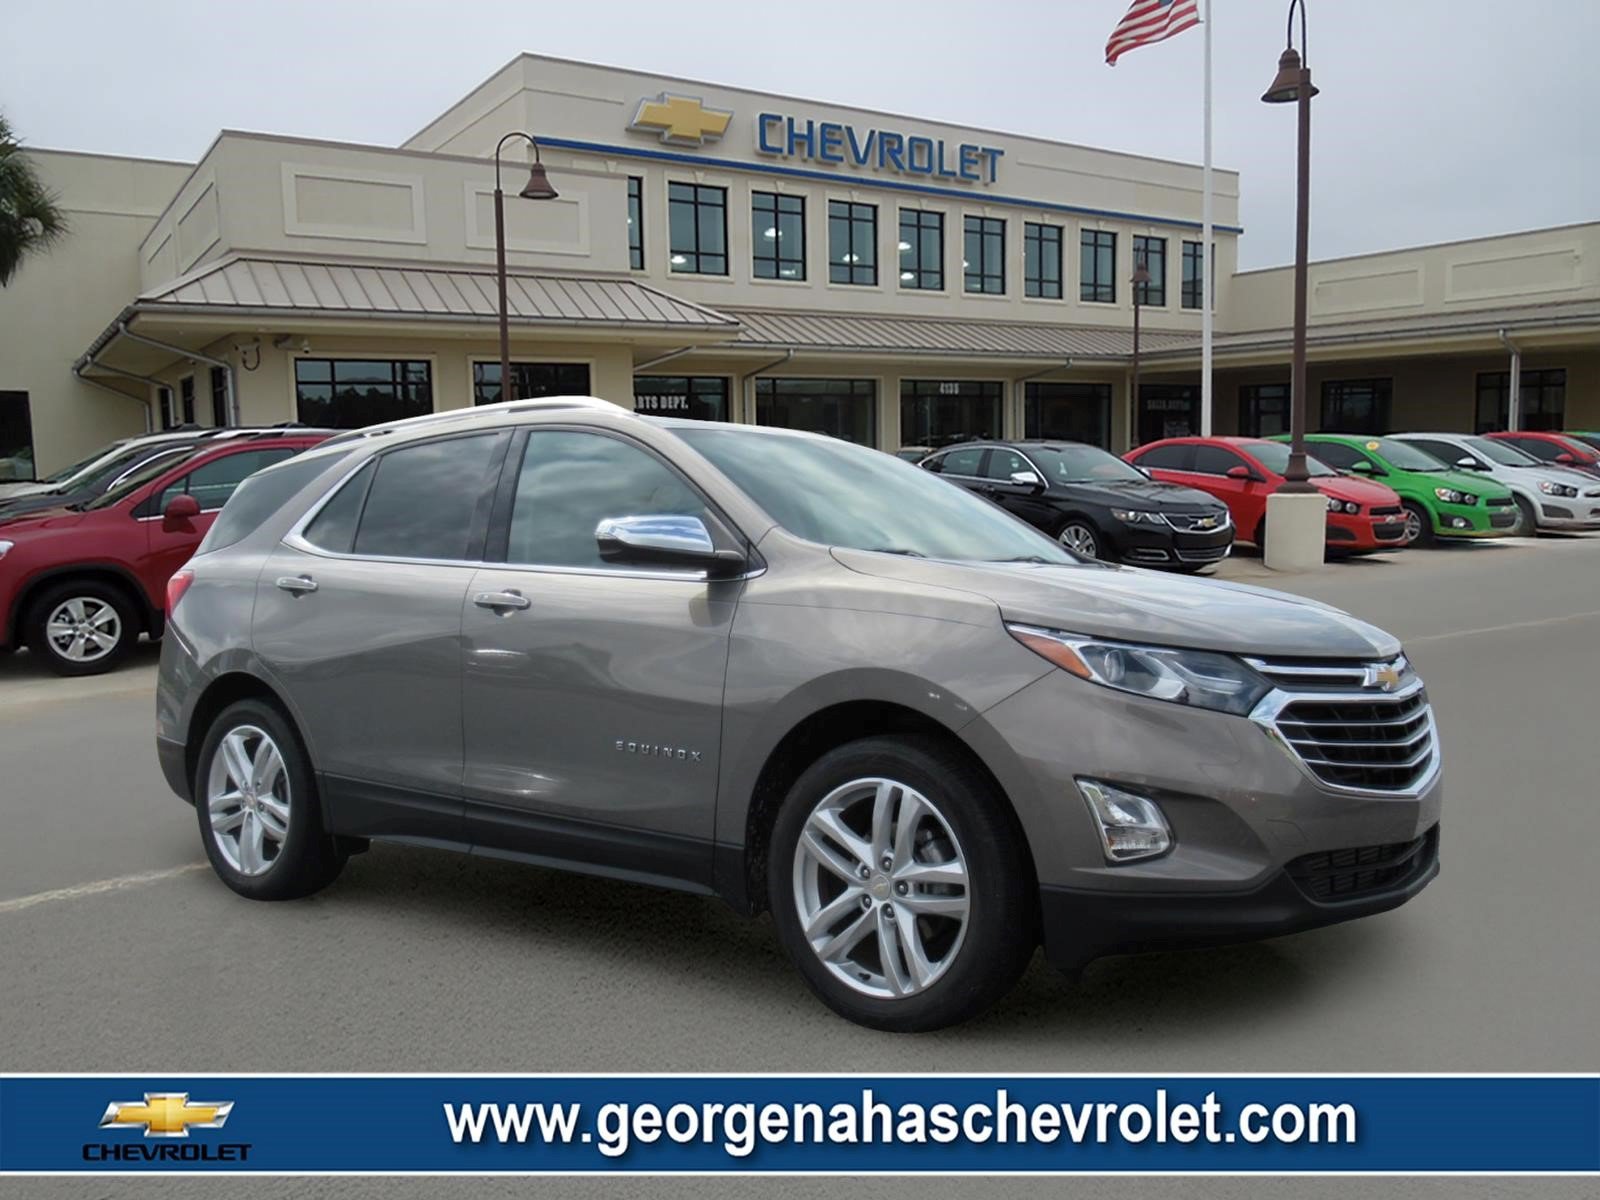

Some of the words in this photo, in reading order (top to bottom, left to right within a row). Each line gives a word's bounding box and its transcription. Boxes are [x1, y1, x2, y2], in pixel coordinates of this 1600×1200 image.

[756, 112, 1005, 184] CHEVROLET
[660, 395, 689, 409] DEPT.
[615, 740, 702, 761] EQUINOX
